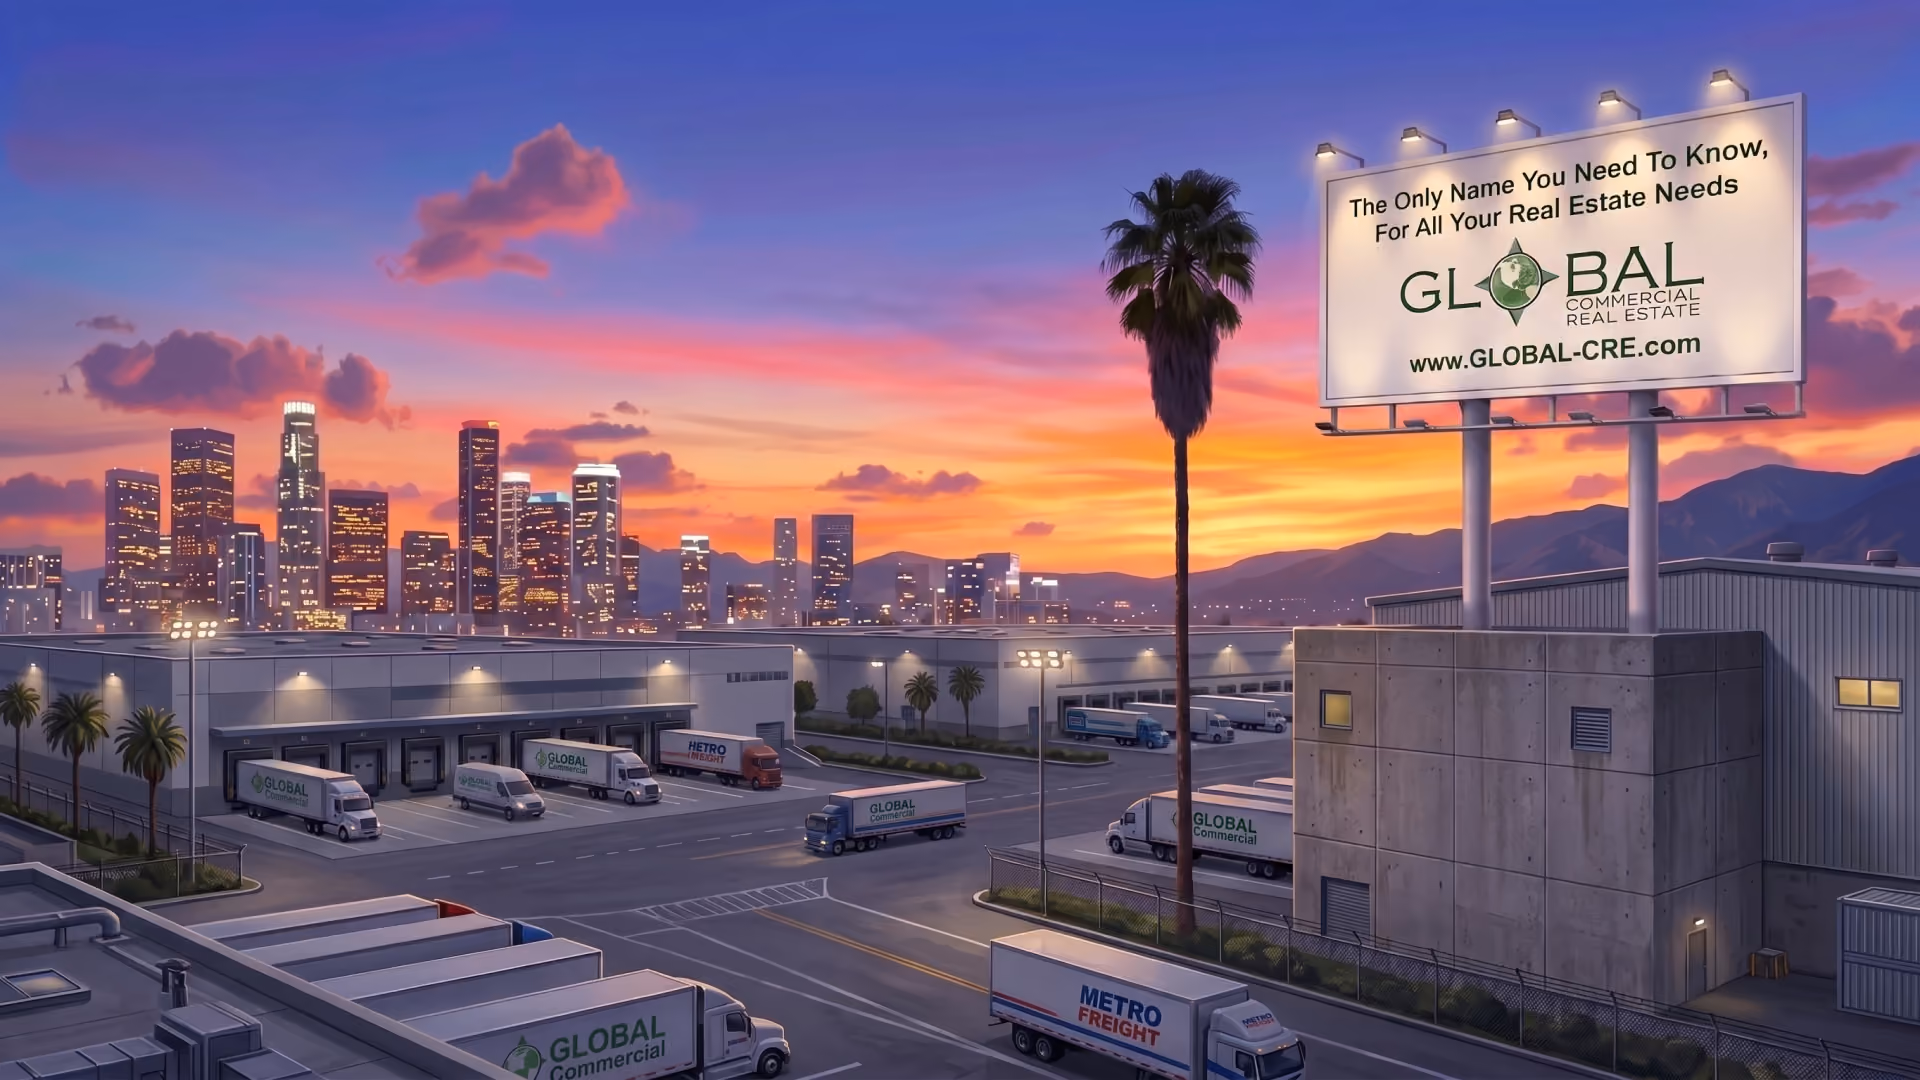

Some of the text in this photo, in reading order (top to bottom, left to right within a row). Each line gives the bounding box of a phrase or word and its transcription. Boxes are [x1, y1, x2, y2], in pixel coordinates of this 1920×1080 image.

[1349, 139, 1768, 218] The Only Name You Need To Know,
[1375, 175, 1738, 243] For All Your Real Estate Needs
[1566, 287, 1700, 312] COMMERCIAL
[1566, 302, 1700, 327] REAL ESTATE
[1409, 336, 1701, 373] www.GLOBAL-CRE.com
[548, 752, 588, 767] GLOBAL
[264, 776, 308, 797] GLOBAL
[870, 799, 916, 814] GLOBAL
[870, 808, 915, 822] Commercial
[1193, 811, 1257, 834] GLOBAL
[1193, 826, 1257, 845] Commercial
[1080, 984, 1162, 1027] METRO
[1078, 1006, 1160, 1046] FREIGHT
[550, 1015, 666, 1063] GLOBAL
[550, 1039, 665, 1080] Commercial
